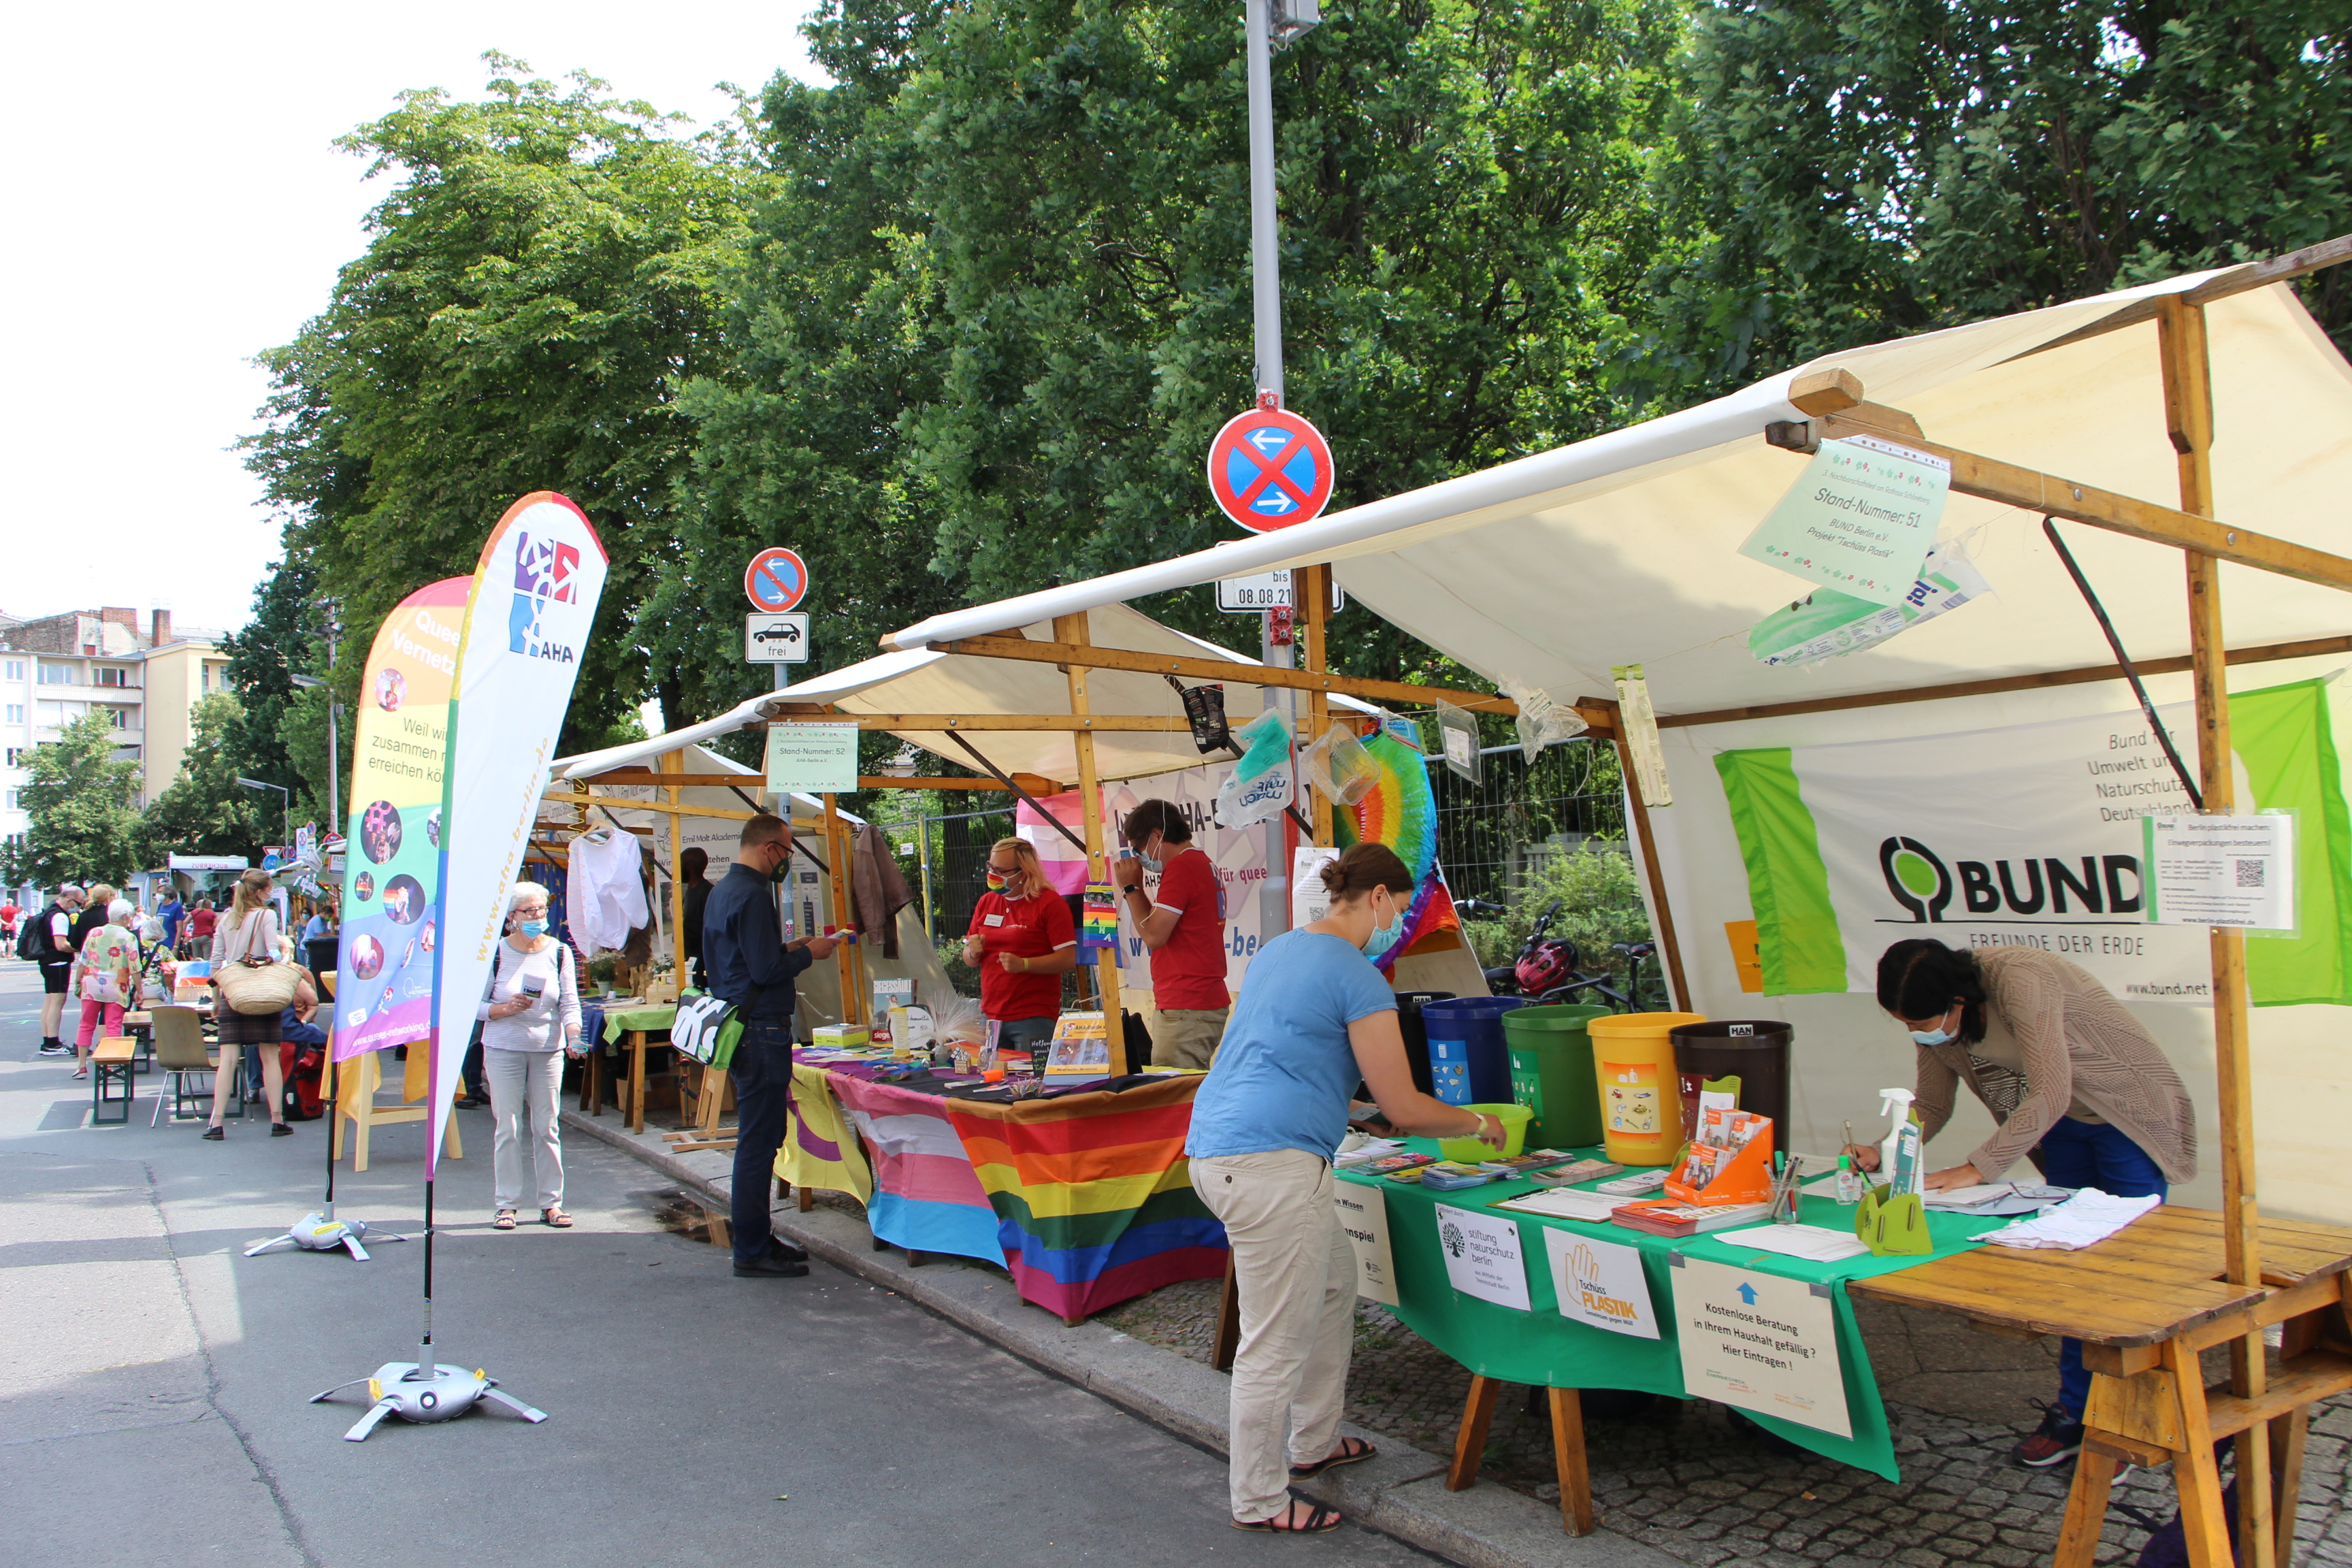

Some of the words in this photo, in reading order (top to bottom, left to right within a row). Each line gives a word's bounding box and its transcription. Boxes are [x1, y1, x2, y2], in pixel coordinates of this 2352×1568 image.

[1885, 486, 1904, 497] Rathaus
[1814, 487, 1906, 525] Stand-Nummer:
[1906, 512, 1921, 528] 51
[1807, 526, 1836, 542] Projekt
[1829, 518, 1854, 532] BUND
[1854, 525, 1875, 539] Berlin
[1875, 532, 1889, 542] e.V.
[1273, 570, 1288, 583] bis
[1239, 588, 1291, 604] 08.08.21
[415, 610, 461, 648] Quee
[392, 627, 456, 677] Vernetz
[541, 641, 573, 664] AHA
[768, 646, 786, 656] frei
[404, 718, 429, 737] Weil
[431, 727, 448, 740] wi
[372, 735, 437, 759] zusammen
[2110, 730, 2147, 749] Bund
[2151, 731, 2175, 744] fr
[779, 747, 834, 755] Stand-Nummer:
[368, 757, 423, 781] erreichen
[426, 770, 444, 783] kö
[2088, 756, 2148, 775] Umwelt
[2096, 777, 2187, 798] Naturschutz
[2100, 799, 2193, 822] Deutschland
[2207, 824, 2239, 832] plastikfrei
[682, 835, 696, 844] Emil
[2168, 839, 2233, 848] Einwegverpackungen
[708, 855, 730, 864] tehen
[1220, 867, 1234, 883] für
[1240, 866, 1267, 884] quee
[1956, 854, 2146, 915] BUND
[2183, 917, 2256, 926] www.berlin-plastikfrei.de
[2059, 934, 2093, 954] DER
[2103, 936, 2144, 956] ERDE
[873, 977, 912, 994] SIEGESSÄULE
[2126, 981, 2208, 995] www.bund.net
[353, 1019, 431, 1047] www.queer-networking.d
[874, 1031, 891, 1041] siege
[1731, 1026, 1752, 1034] HAN
[1341, 1198, 1364, 1211] Wissen
[1468, 1229, 1497, 1246] stiftung
[1470, 1241, 1515, 1260] naturschutz
[1471, 1253, 1493, 1267] berlin
[1482, 1271, 1496, 1279] Mitteln
[1497, 1283, 1510, 1291] Berlin
[1578, 1279, 1606, 1295] Tschüss
[1581, 1291, 1639, 1320] PLASTIK
[1584, 1309, 1608, 1320] Gemeinsam
[1705, 1302, 1754, 1323] Kostenlose
[1755, 1315, 1799, 1337] Beratung
[1693, 1318, 1703, 1329] in
[1704, 1321, 1731, 1336] Ihrem
[1733, 1328, 1774, 1348] Haushalt
[1775, 1340, 1809, 1359] gefällig
[1810, 1348, 1816, 1358] ?
[1722, 1343, 1741, 1357] Hier
[1743, 1349, 1787, 1369] Eintragen
[1788, 1360, 1793, 1371] !
[1705, 1371, 1746, 1385] ENERGIECHECK
